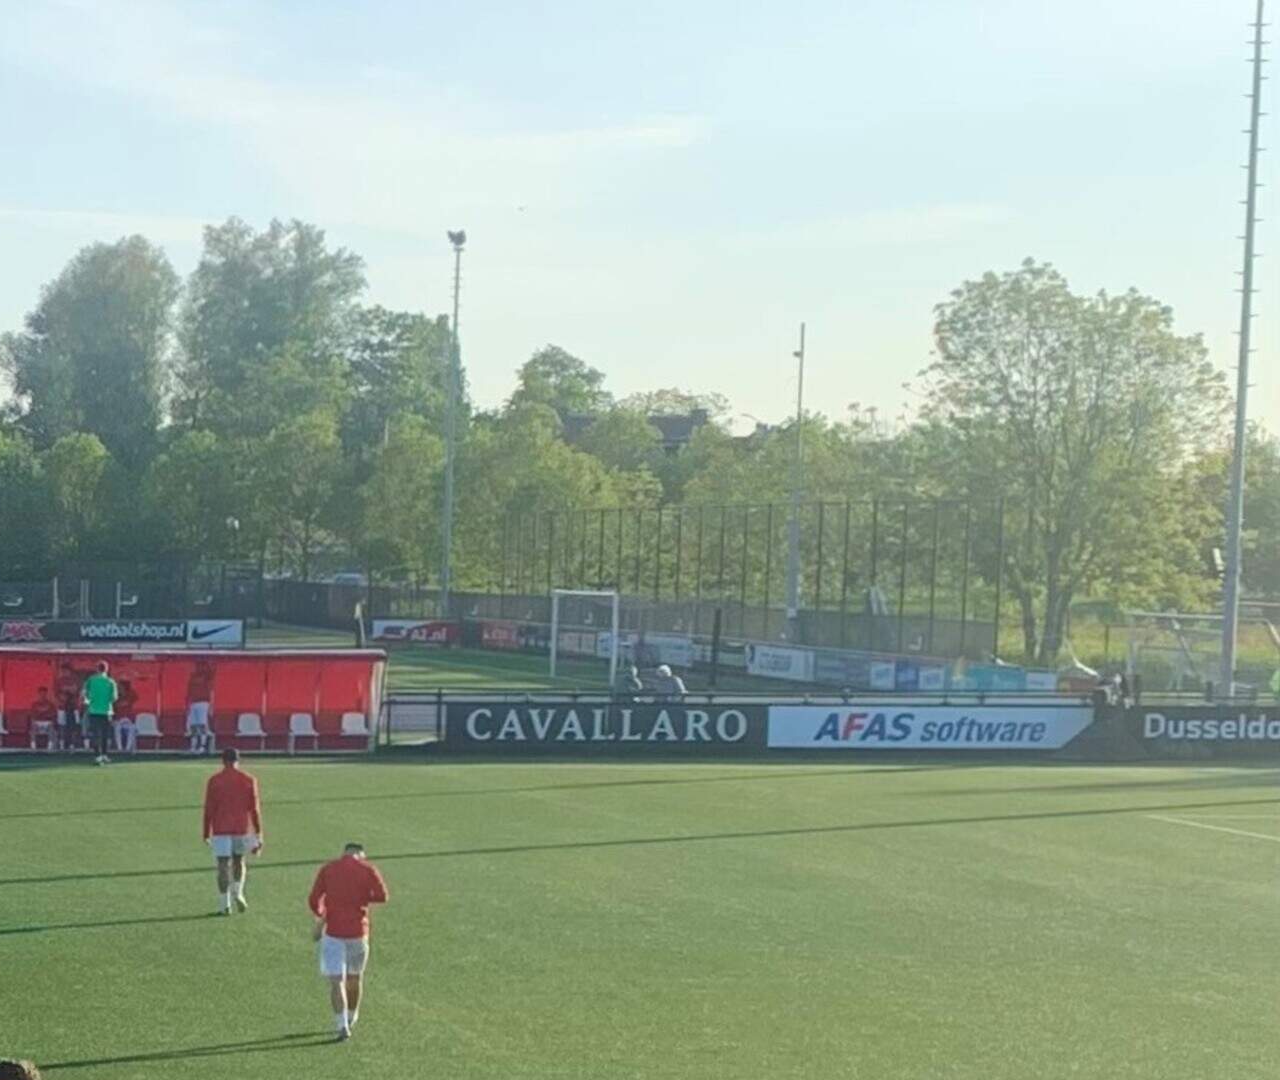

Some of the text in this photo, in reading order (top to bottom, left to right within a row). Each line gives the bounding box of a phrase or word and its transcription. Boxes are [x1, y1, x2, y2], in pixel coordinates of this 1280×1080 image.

[80, 621, 186, 639] voetbalshop.nl
[466, 708, 748, 741] CAVALLARO
[813, 713, 1047, 742] AFAS software
